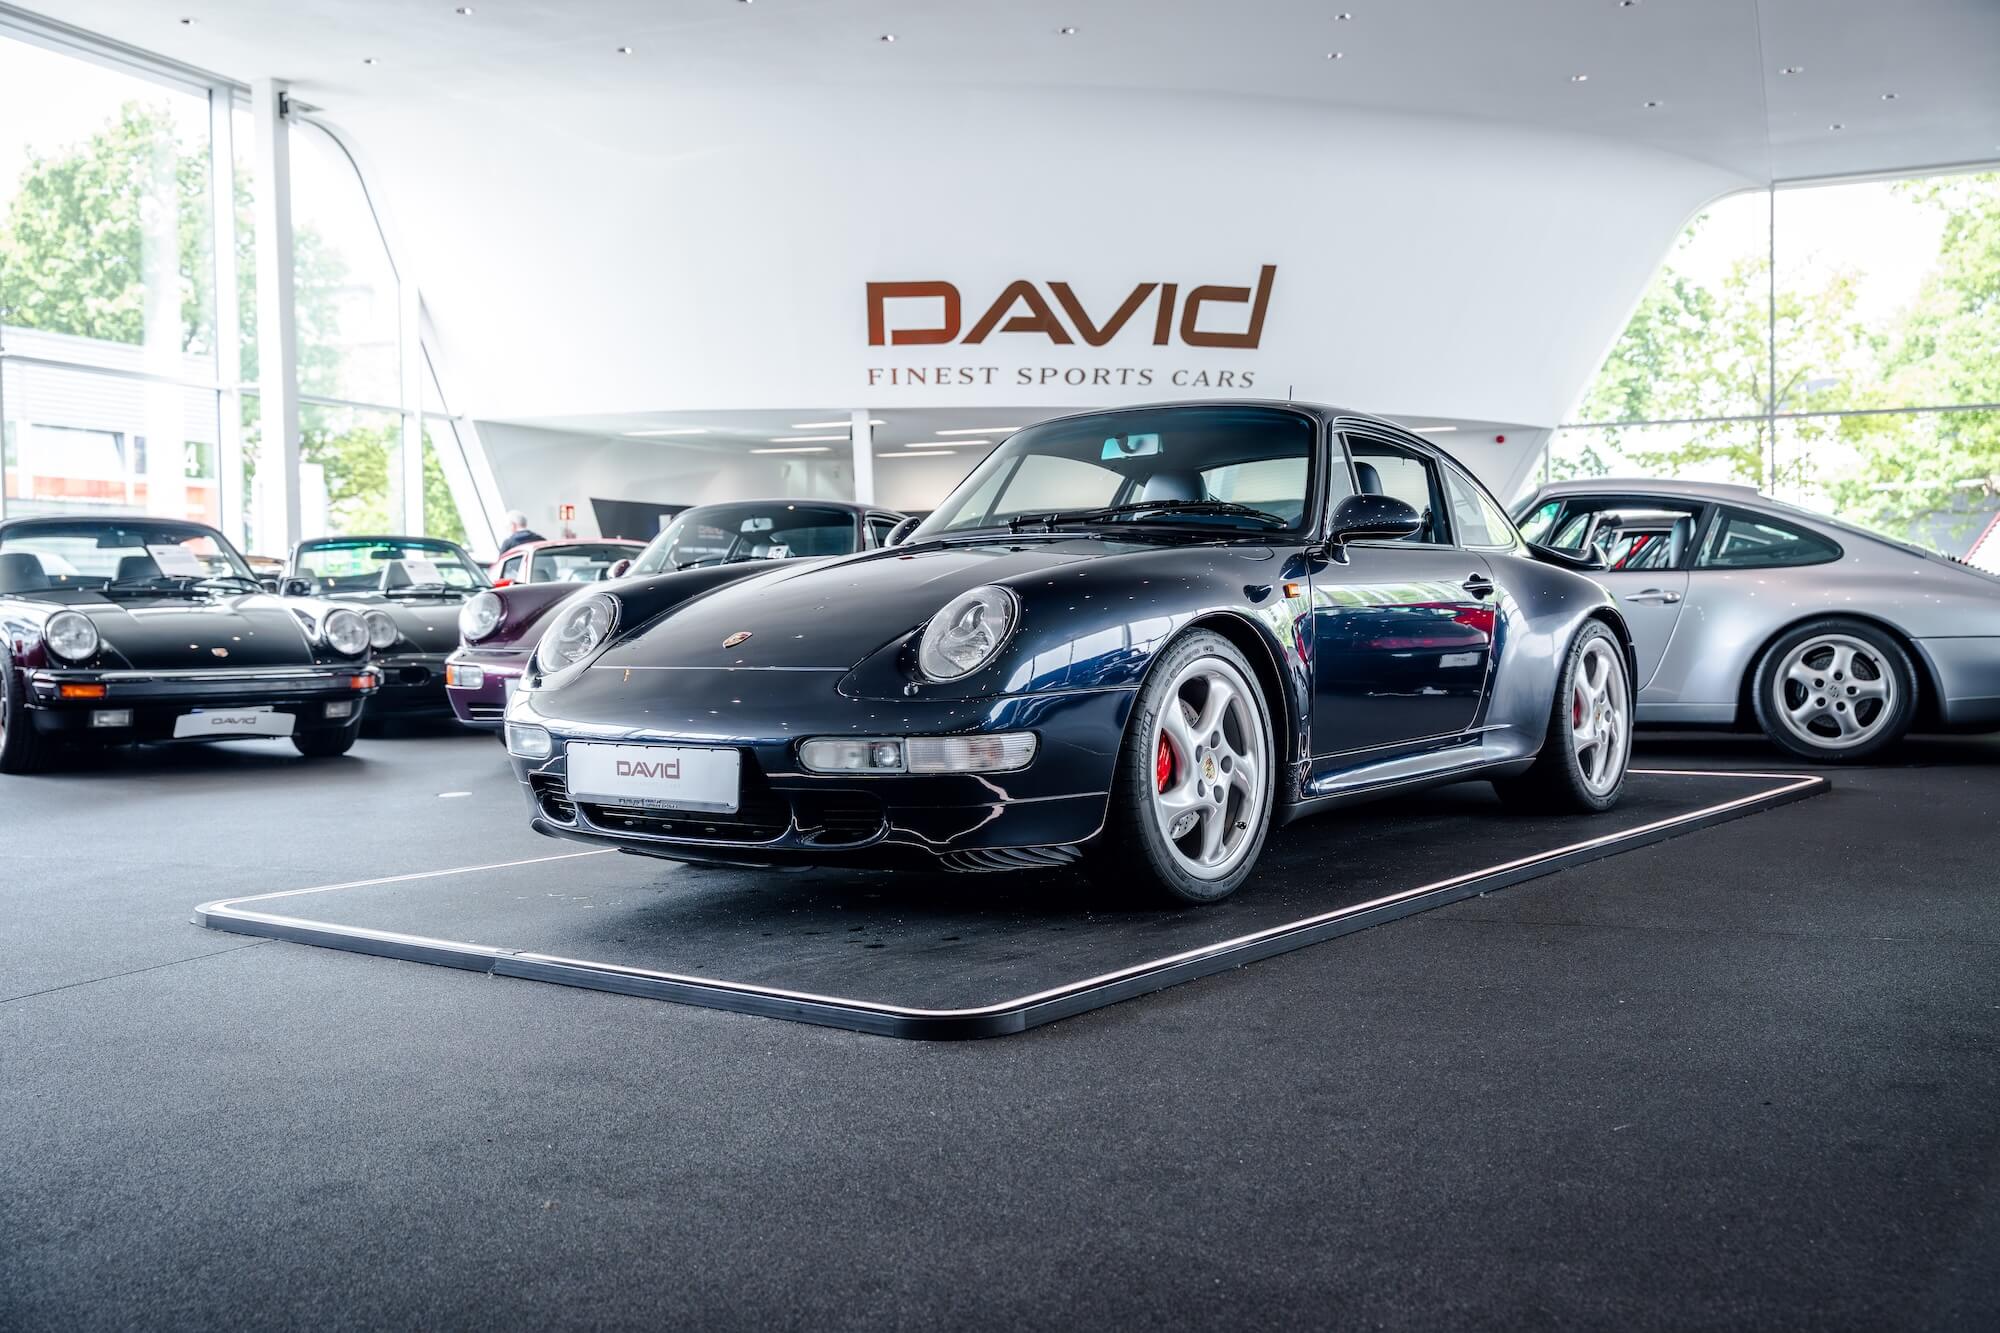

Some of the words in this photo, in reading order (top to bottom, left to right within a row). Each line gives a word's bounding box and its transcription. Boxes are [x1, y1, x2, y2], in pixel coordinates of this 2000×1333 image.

[868, 367, 999, 386] FINEST
[1017, 367, 1154, 386] SPORTS
[1171, 369, 1255, 389] CARS
[1139, 711, 1152, 783] MICHELIN
